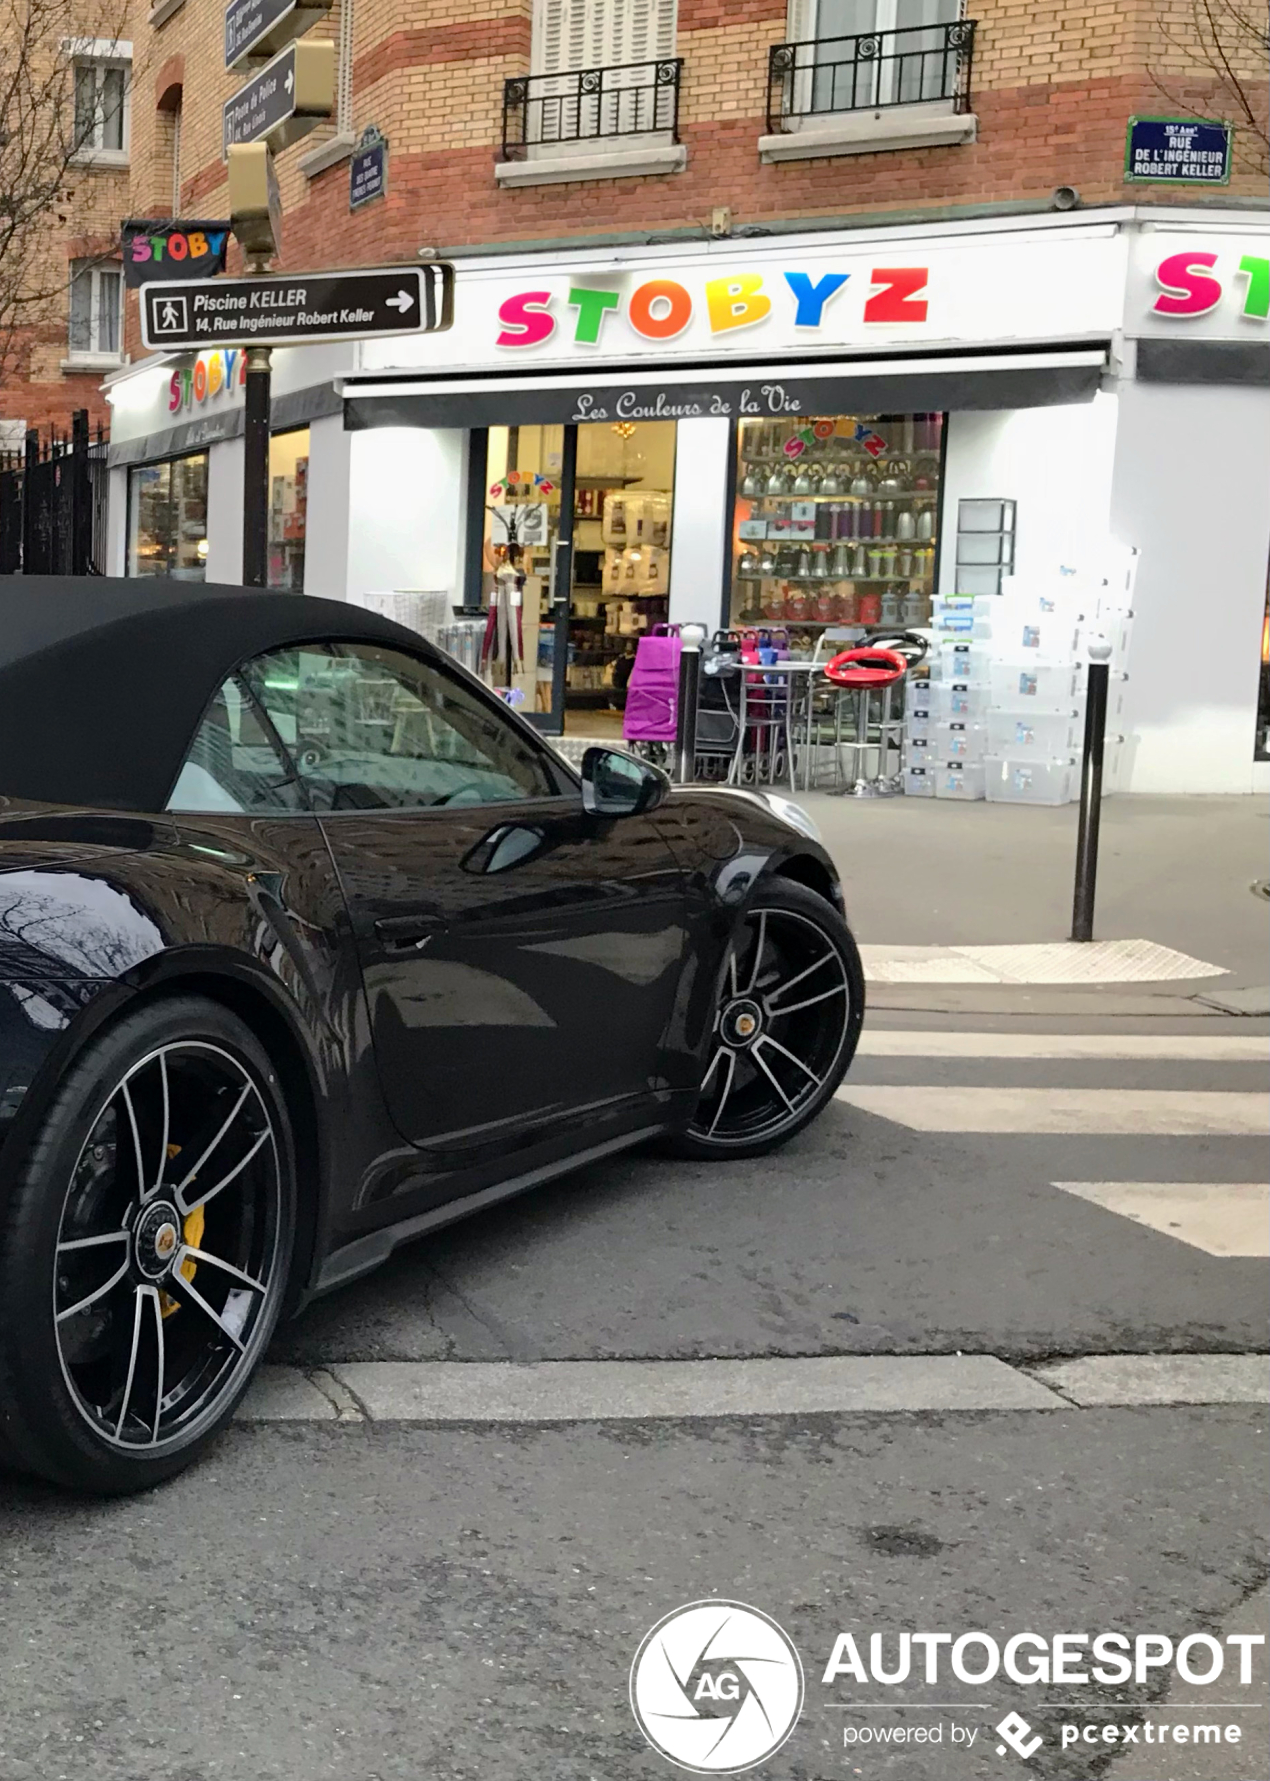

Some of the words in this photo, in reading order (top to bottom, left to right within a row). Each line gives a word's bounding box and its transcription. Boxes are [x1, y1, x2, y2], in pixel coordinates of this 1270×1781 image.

[235, 102, 249, 123] Poste
[251, 92, 258, 110] de
[259, 78, 277, 103] Police
[1135, 149, 1150, 161] DE
[1169, 137, 1192, 149] RUE
[1134, 162, 1178, 175] ROBERT
[1181, 164, 1223, 177] KELLER
[131, 232, 231, 263] STOBY
[193, 293, 247, 312] Piscine
[249, 289, 307, 309] KELLER
[495, 267, 930, 349] STOBYZ
[196, 317, 212, 333] 14,
[213, 315, 237, 331] Rue
[239, 313, 295, 332] Ingénieur
[296, 311, 338, 326] Robert
[339, 308, 375, 323] Keller
[572, 394, 608, 421] Les
[616, 391, 702, 418] Couleurs
[709, 395, 732, 414] de
[738, 389, 760, 413] la
[761, 384, 801, 412] Vie
[783, 419, 889, 461] STOBYZ
[489, 470, 556, 499] STOBYZ
